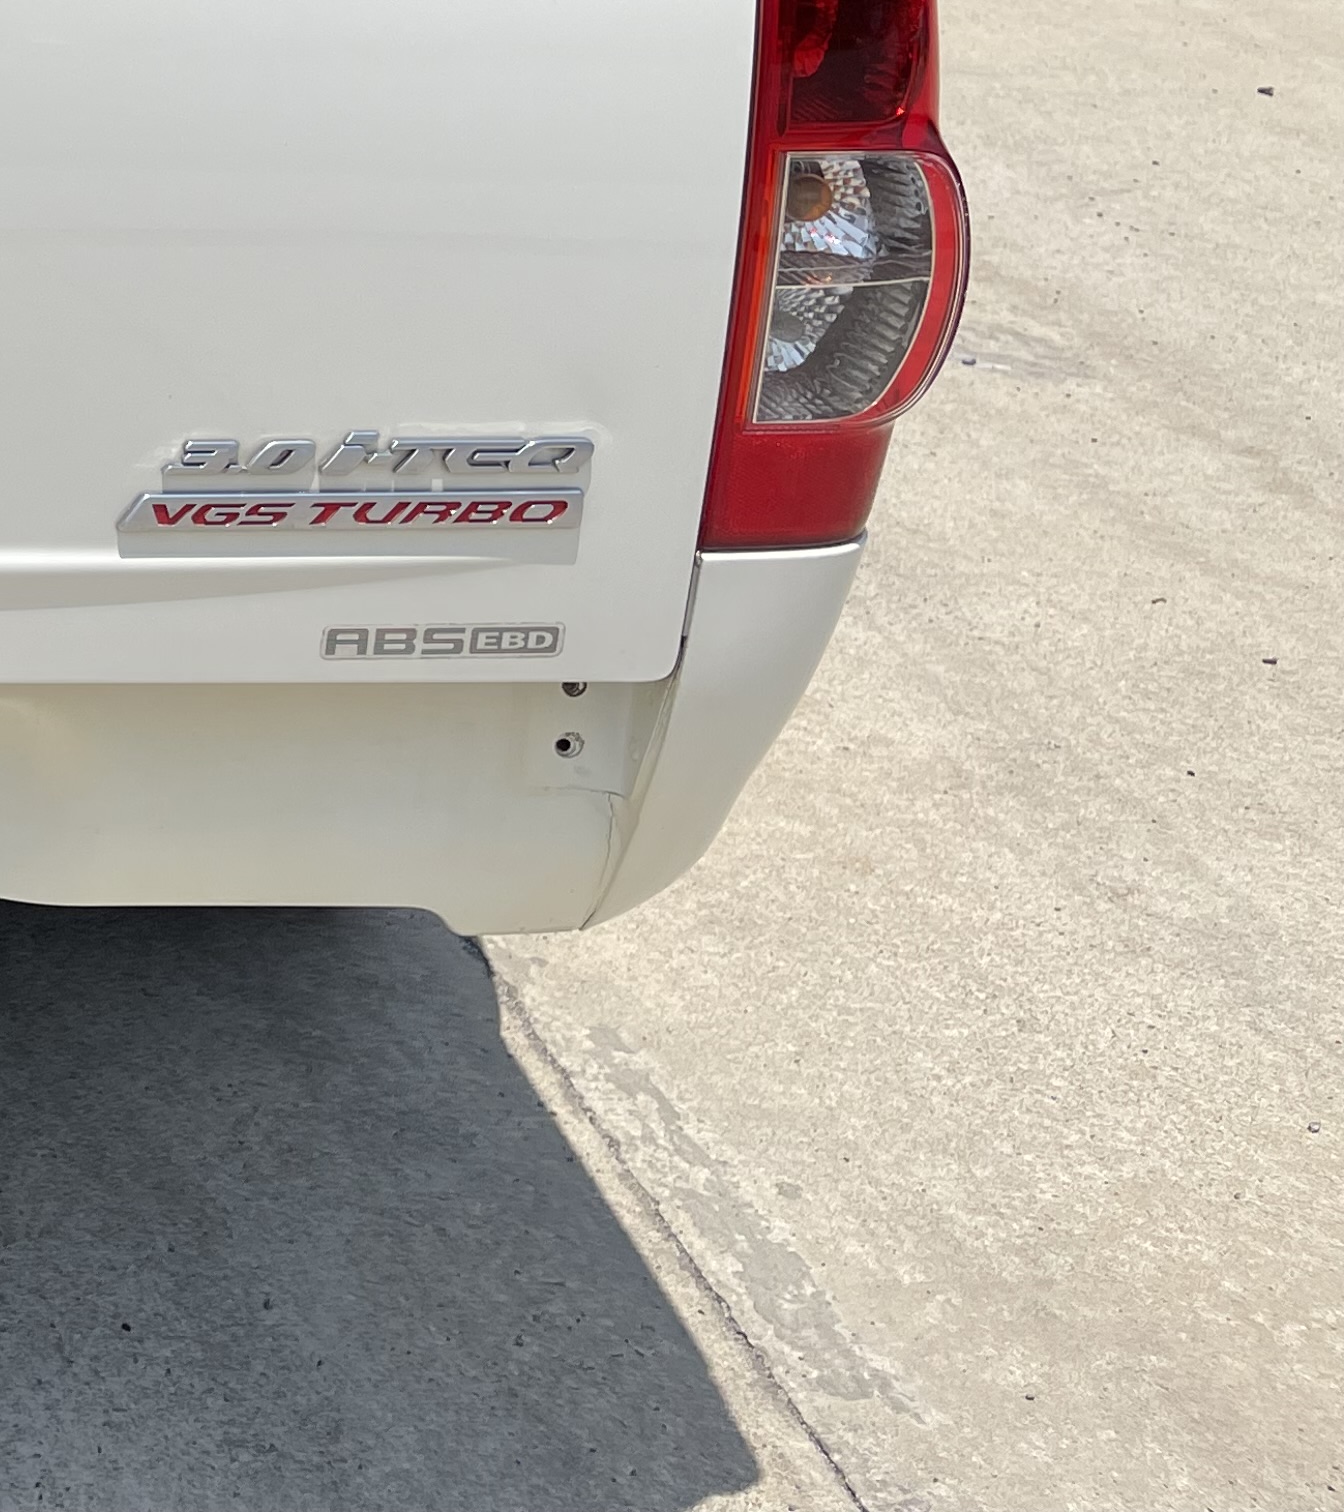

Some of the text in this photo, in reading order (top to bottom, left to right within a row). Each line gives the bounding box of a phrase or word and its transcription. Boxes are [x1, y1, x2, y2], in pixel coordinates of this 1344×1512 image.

[162, 439, 315, 476] 3.0
[150, 499, 569, 527] VGS TURBO
[323, 626, 557, 657] ABS EBD
